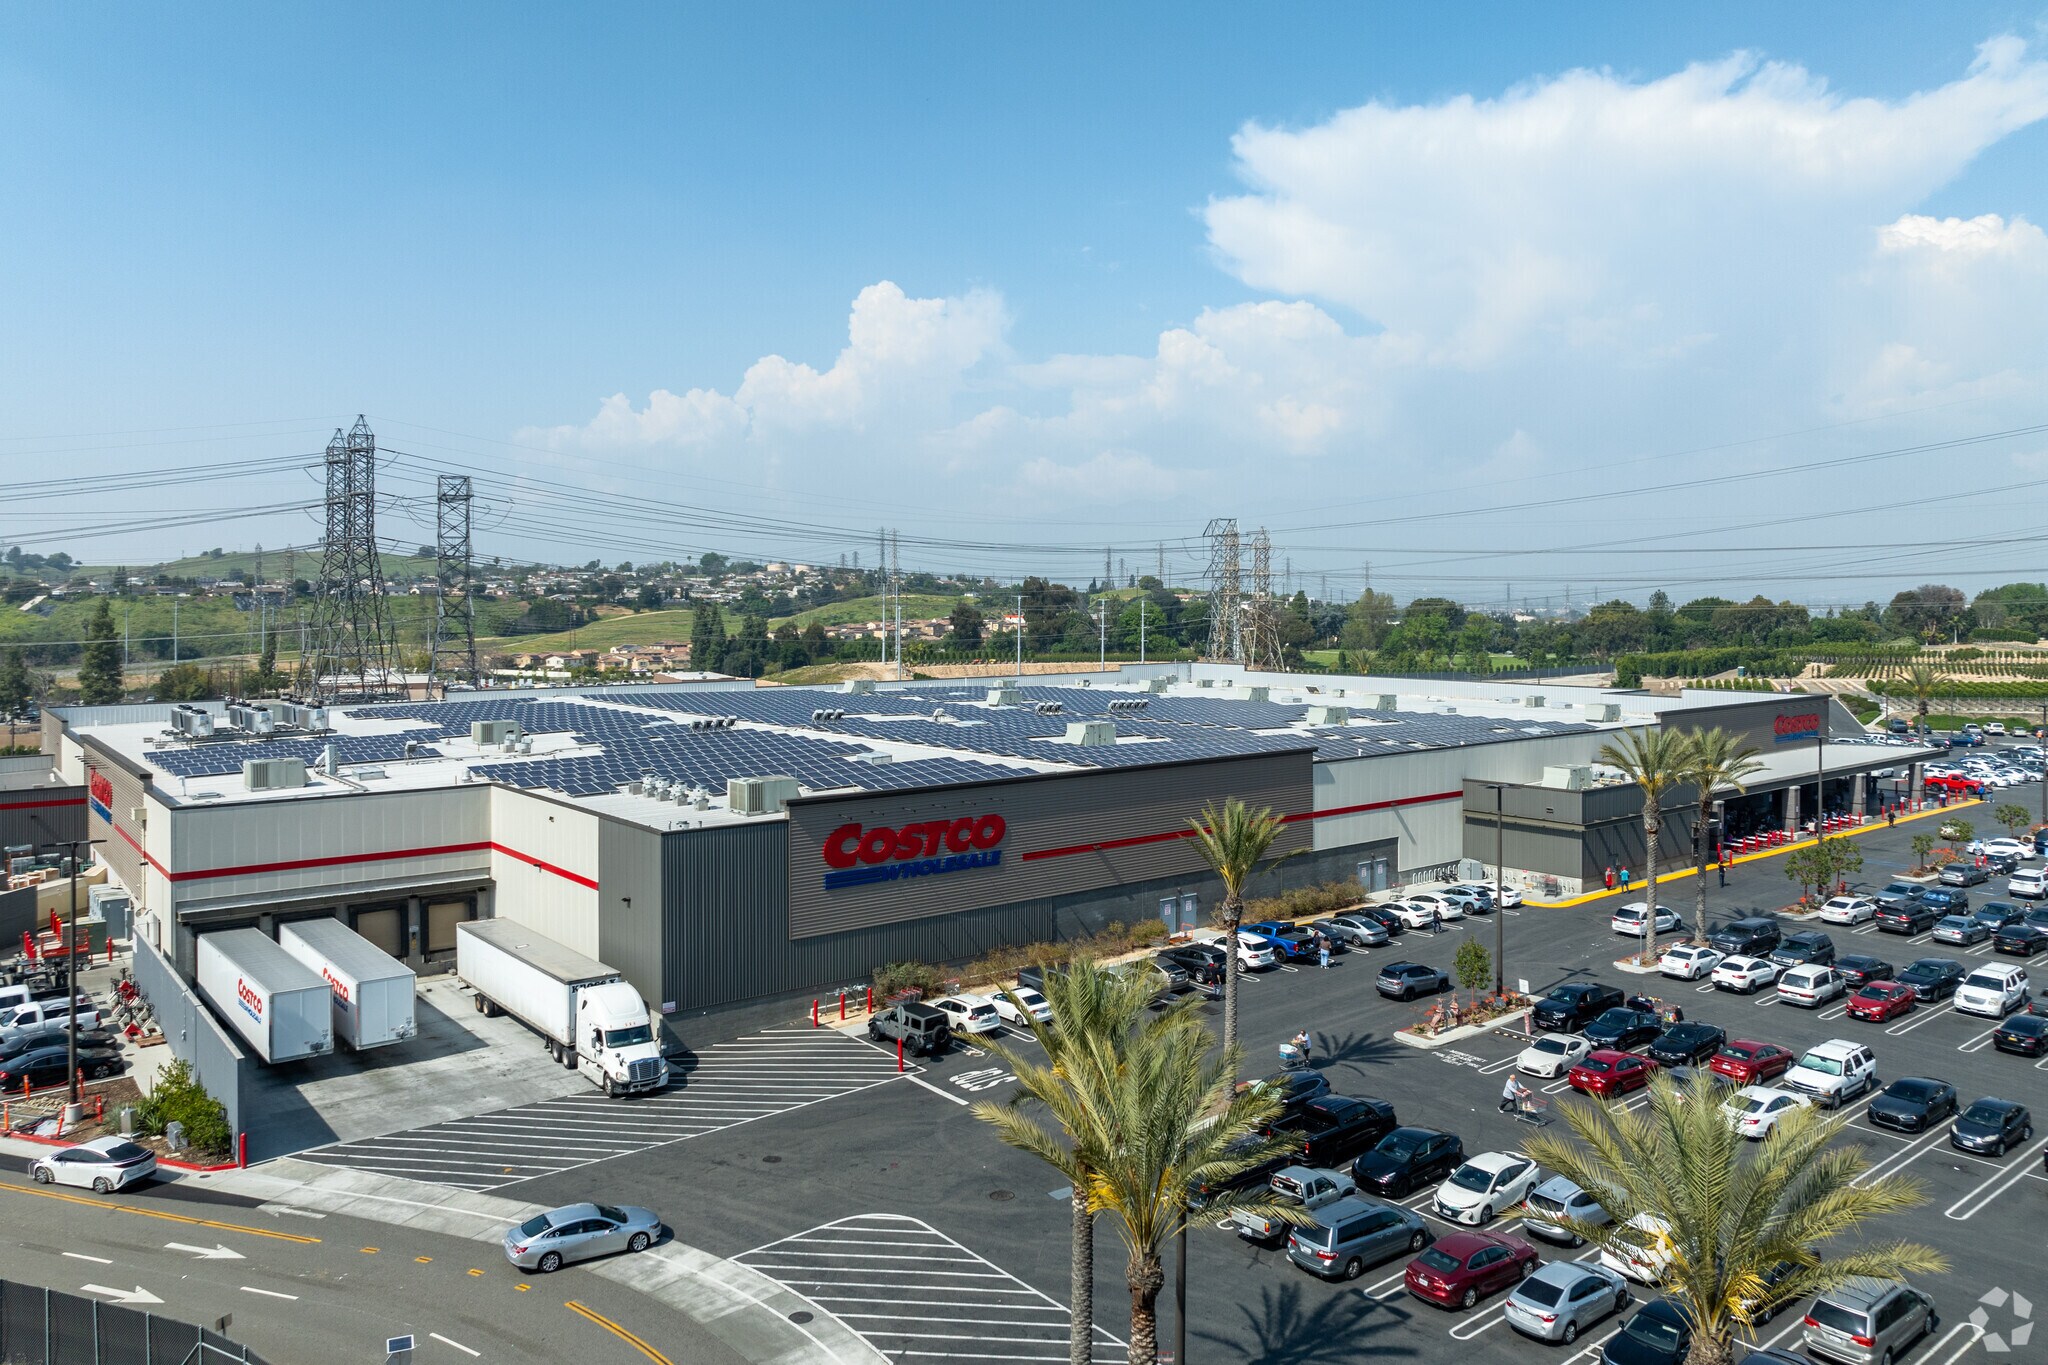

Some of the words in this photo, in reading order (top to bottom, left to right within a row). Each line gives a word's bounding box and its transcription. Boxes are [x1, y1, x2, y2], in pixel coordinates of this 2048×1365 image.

[1774, 713, 1820, 735] COSTCO
[822, 813, 1006, 868] COSTCO
[881, 850, 1002, 882] WHOLESALE
[238, 978, 263, 1015] COSTCO
